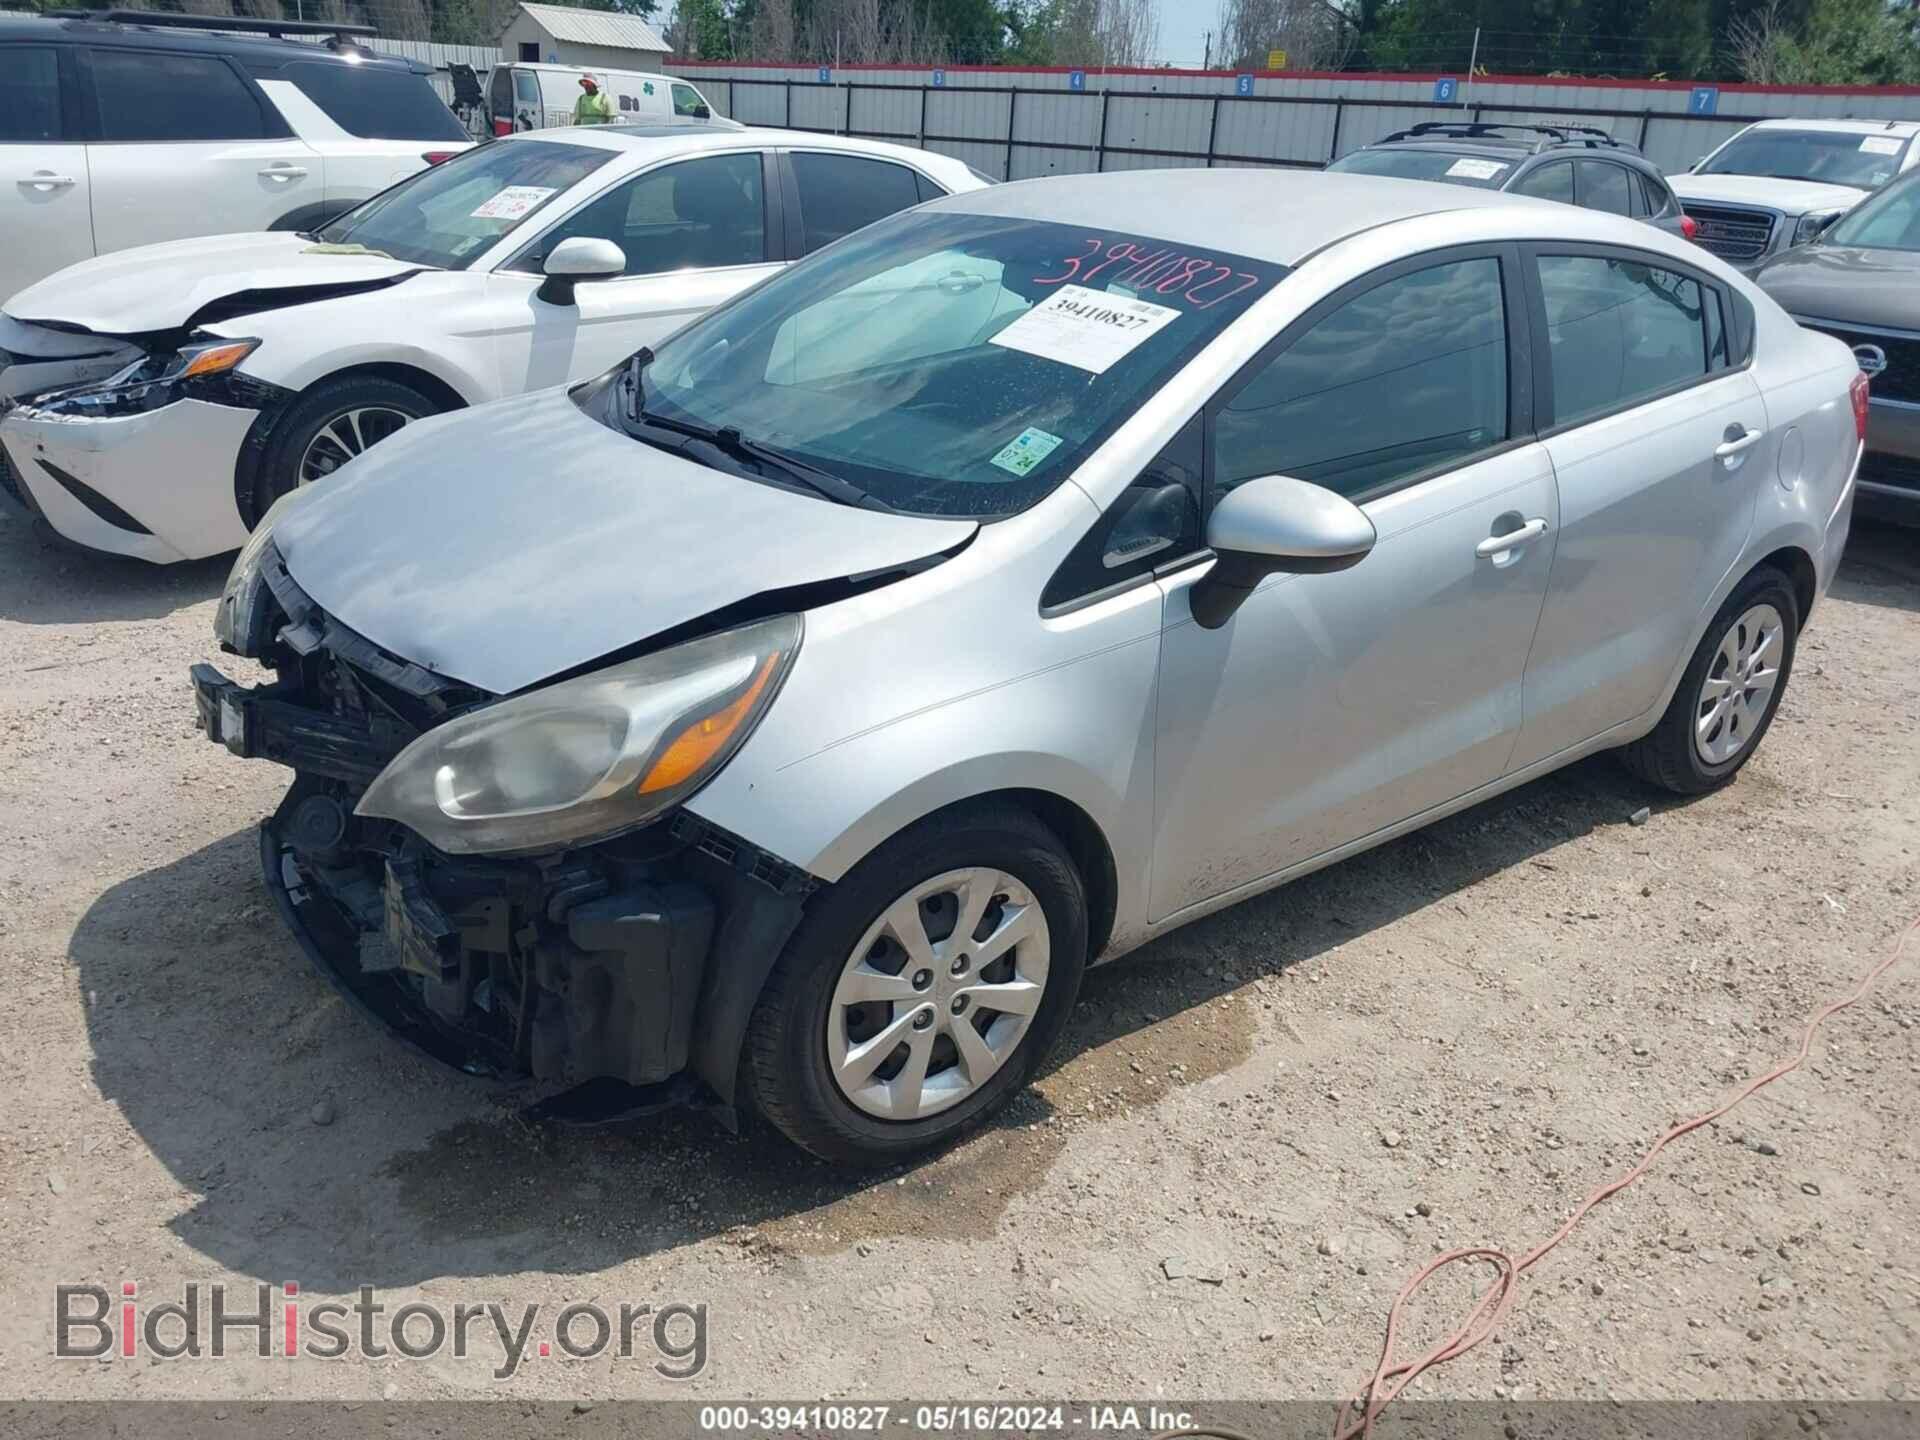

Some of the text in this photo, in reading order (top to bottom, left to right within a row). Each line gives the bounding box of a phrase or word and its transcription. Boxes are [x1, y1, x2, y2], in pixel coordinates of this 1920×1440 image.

[1072, 73, 1081, 86] 4
[1440, 83, 1450, 97] 6
[1698, 93, 1709, 109] 7
[1033, 239, 1258, 310] 39410827
[1048, 299, 1149, 330] 39410827
[1001, 449, 1034, 468] 07 24
